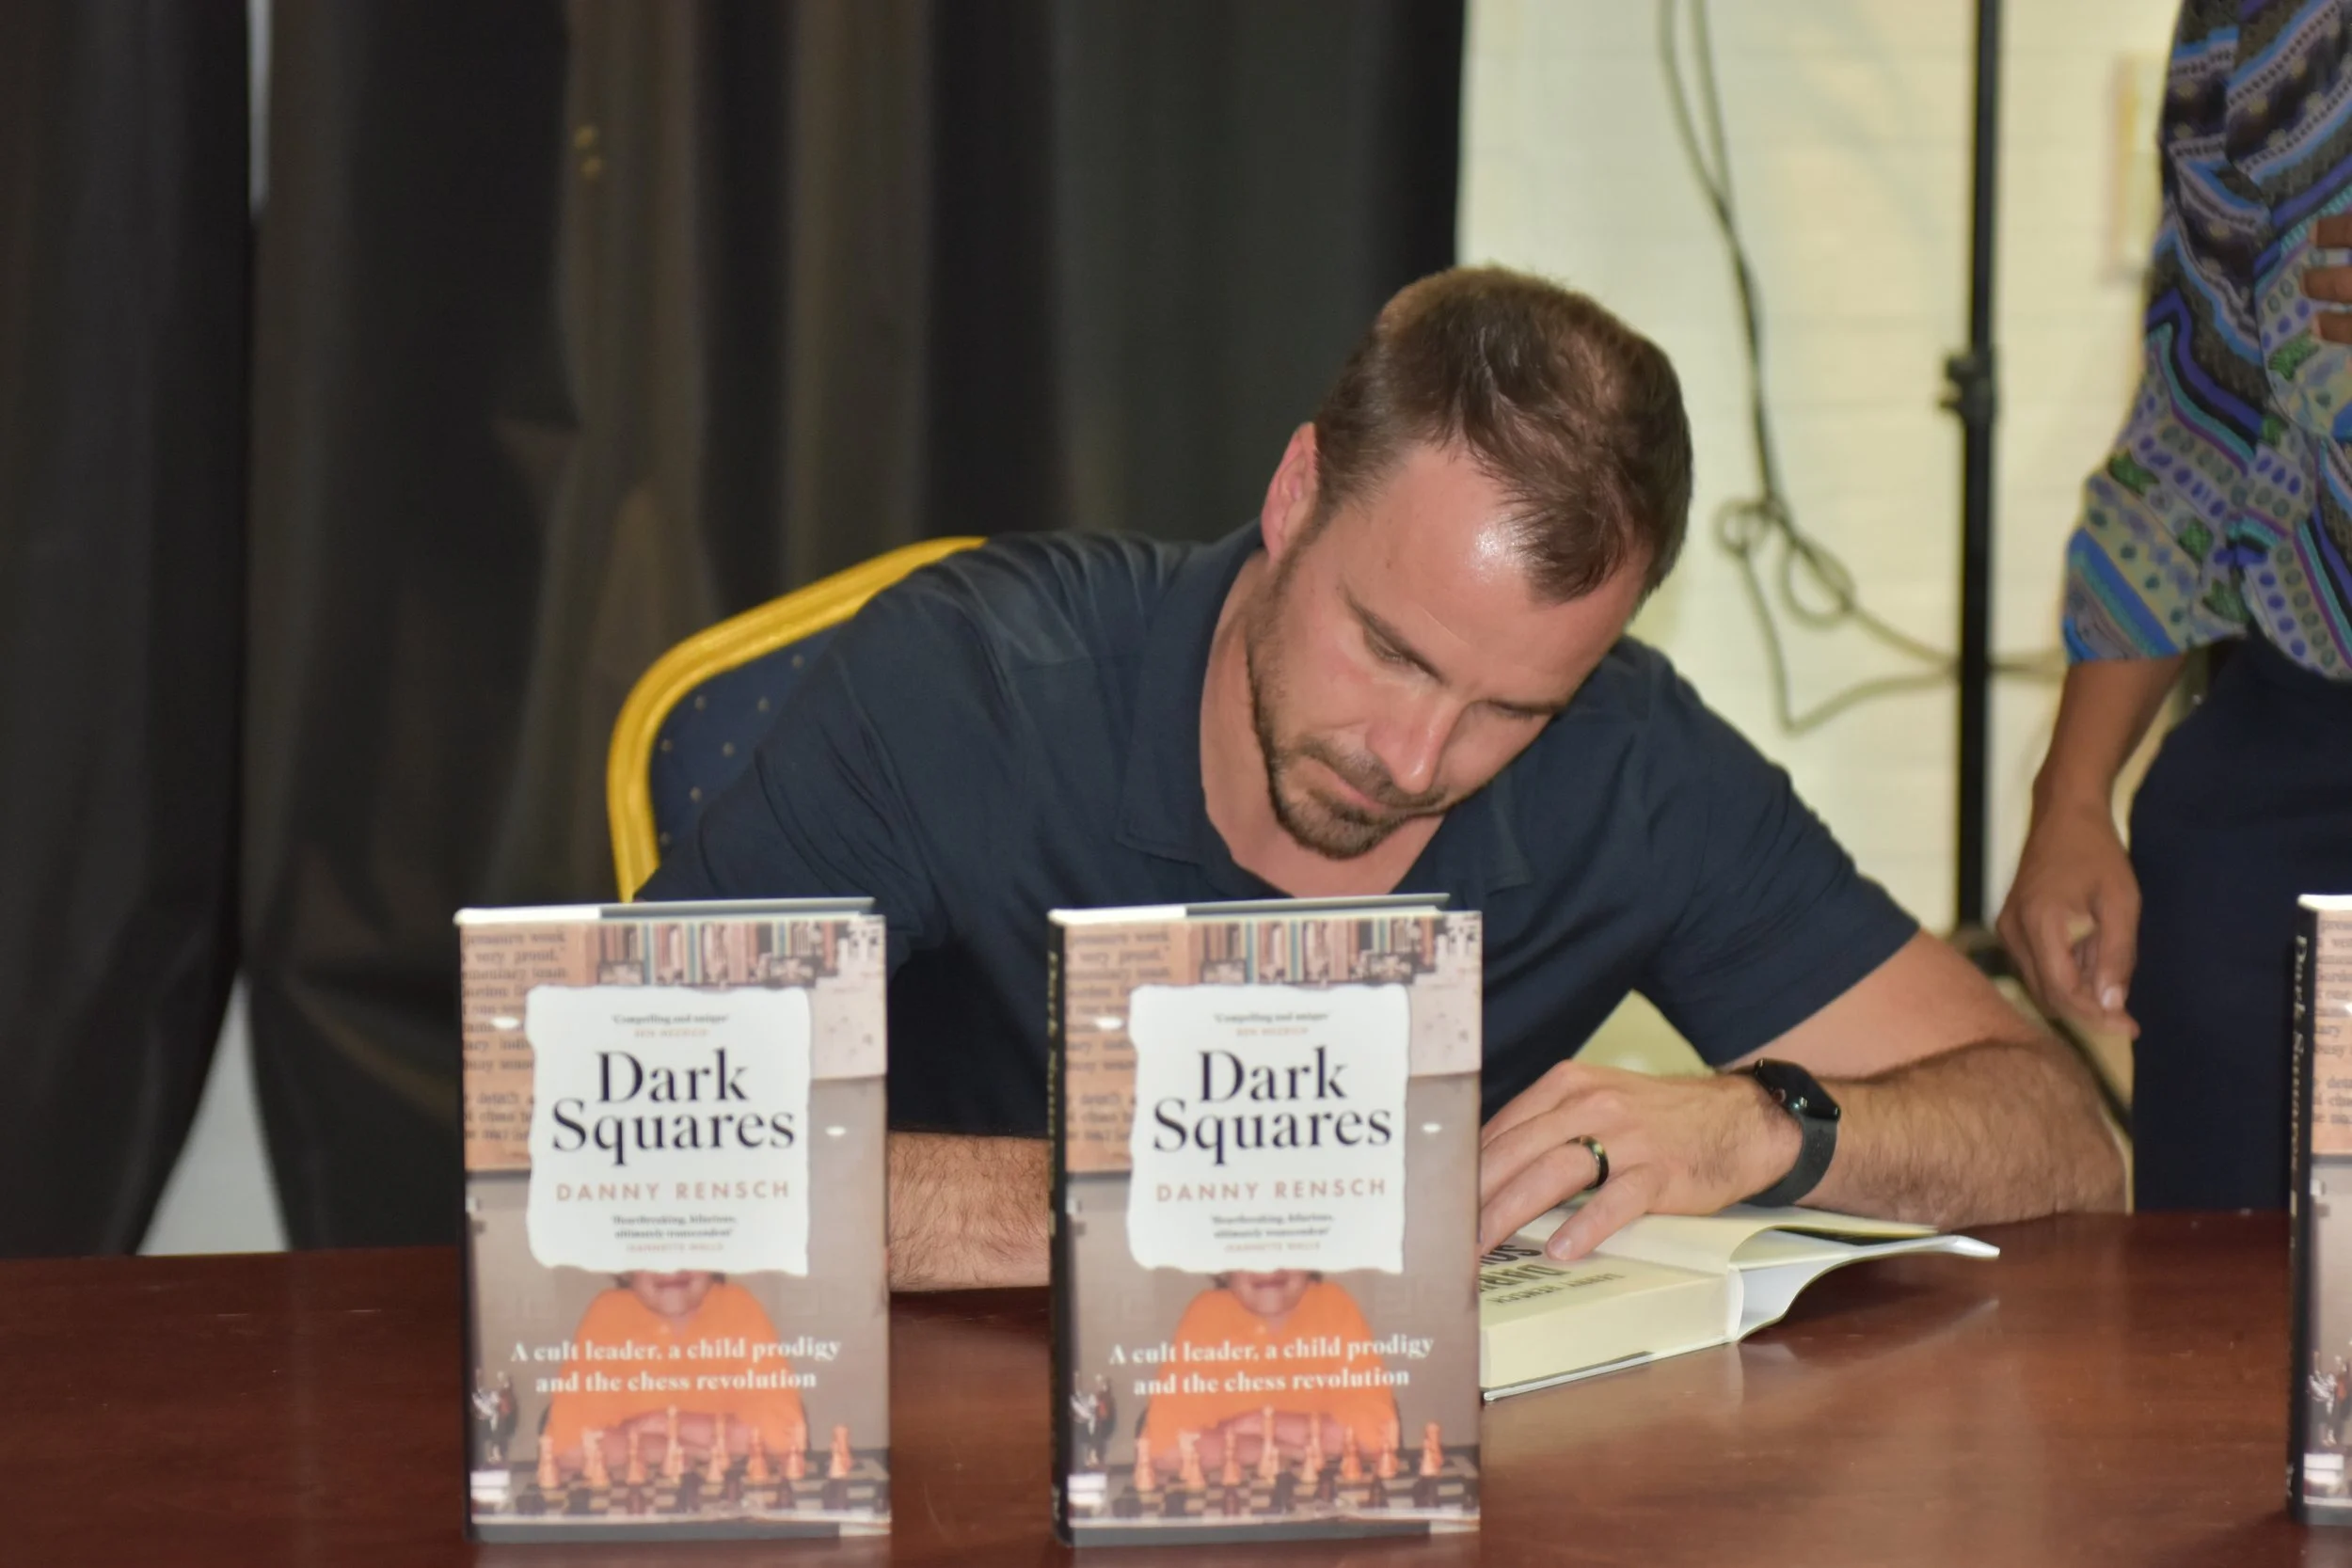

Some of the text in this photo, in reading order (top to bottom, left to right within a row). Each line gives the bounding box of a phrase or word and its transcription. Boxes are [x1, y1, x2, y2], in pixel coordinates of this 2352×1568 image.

[596, 1048, 749, 1103] Dark
[1198, 1046, 1348, 1102] Dark
[551, 1098, 795, 1166] Squares
[1152, 1098, 1392, 1165] Squares
[556, 1180, 789, 1202] DANNY RENSCH
[1156, 1178, 1386, 1202] DANNY RENSCH
[510, 1342, 530, 1362] A
[533, 1339, 580, 1361] cult
[668, 1345, 681, 1359] a
[686, 1337, 746, 1359] child
[753, 1336, 842, 1364] prodigy
[1109, 1333, 1435, 1364] A cult leader, a child prodigy
[535, 1368, 818, 1392] and the chess revolution
[1133, 1367, 1410, 1395] and the chess revolution
